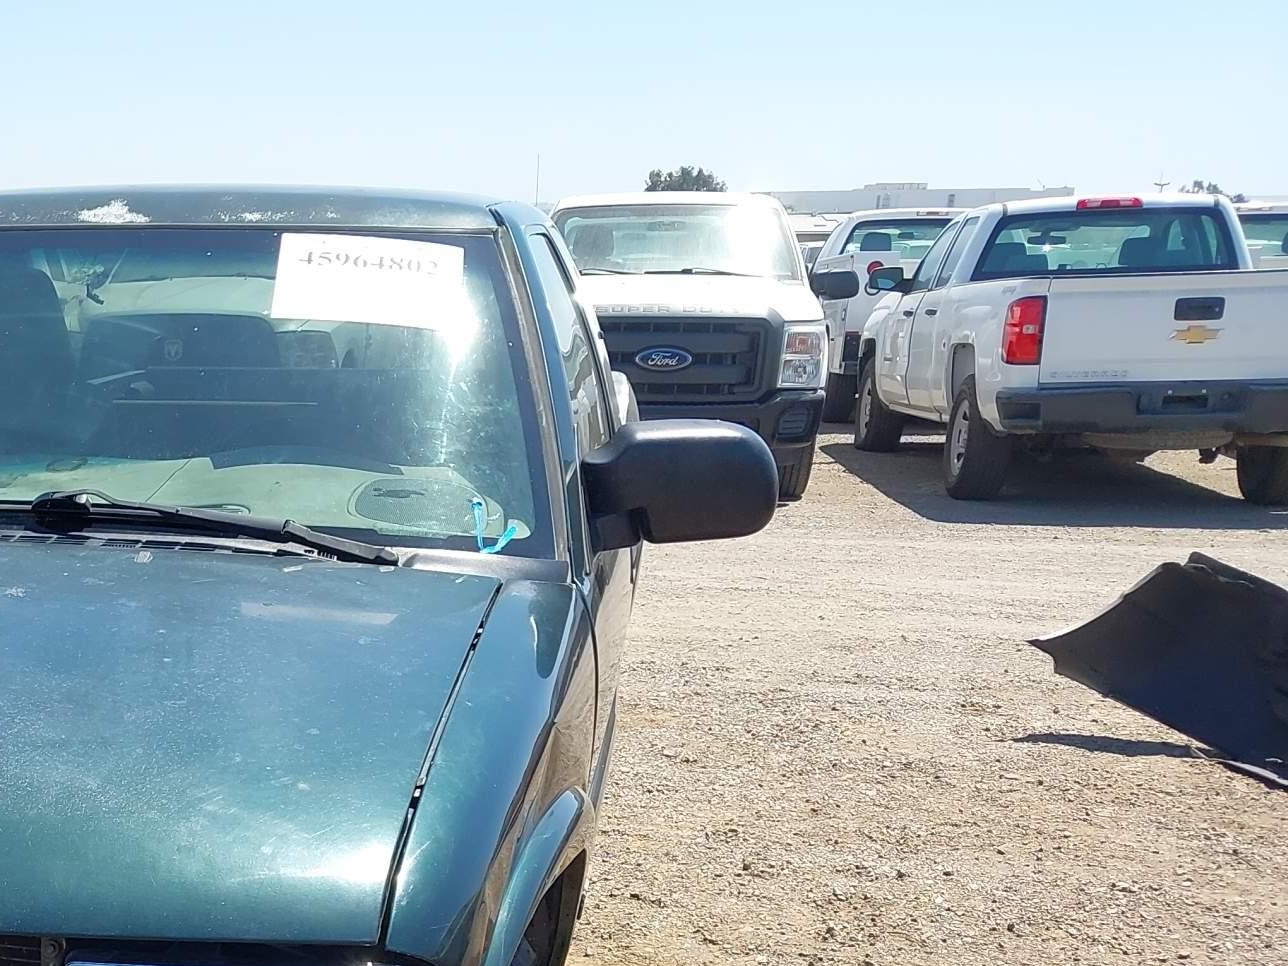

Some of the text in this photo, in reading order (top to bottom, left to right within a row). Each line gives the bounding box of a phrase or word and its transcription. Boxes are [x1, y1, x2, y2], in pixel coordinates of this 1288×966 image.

[298, 251, 439, 276] 45964802
[593, 304, 672, 313] SUPER
[648, 352, 679, 367] Ford
